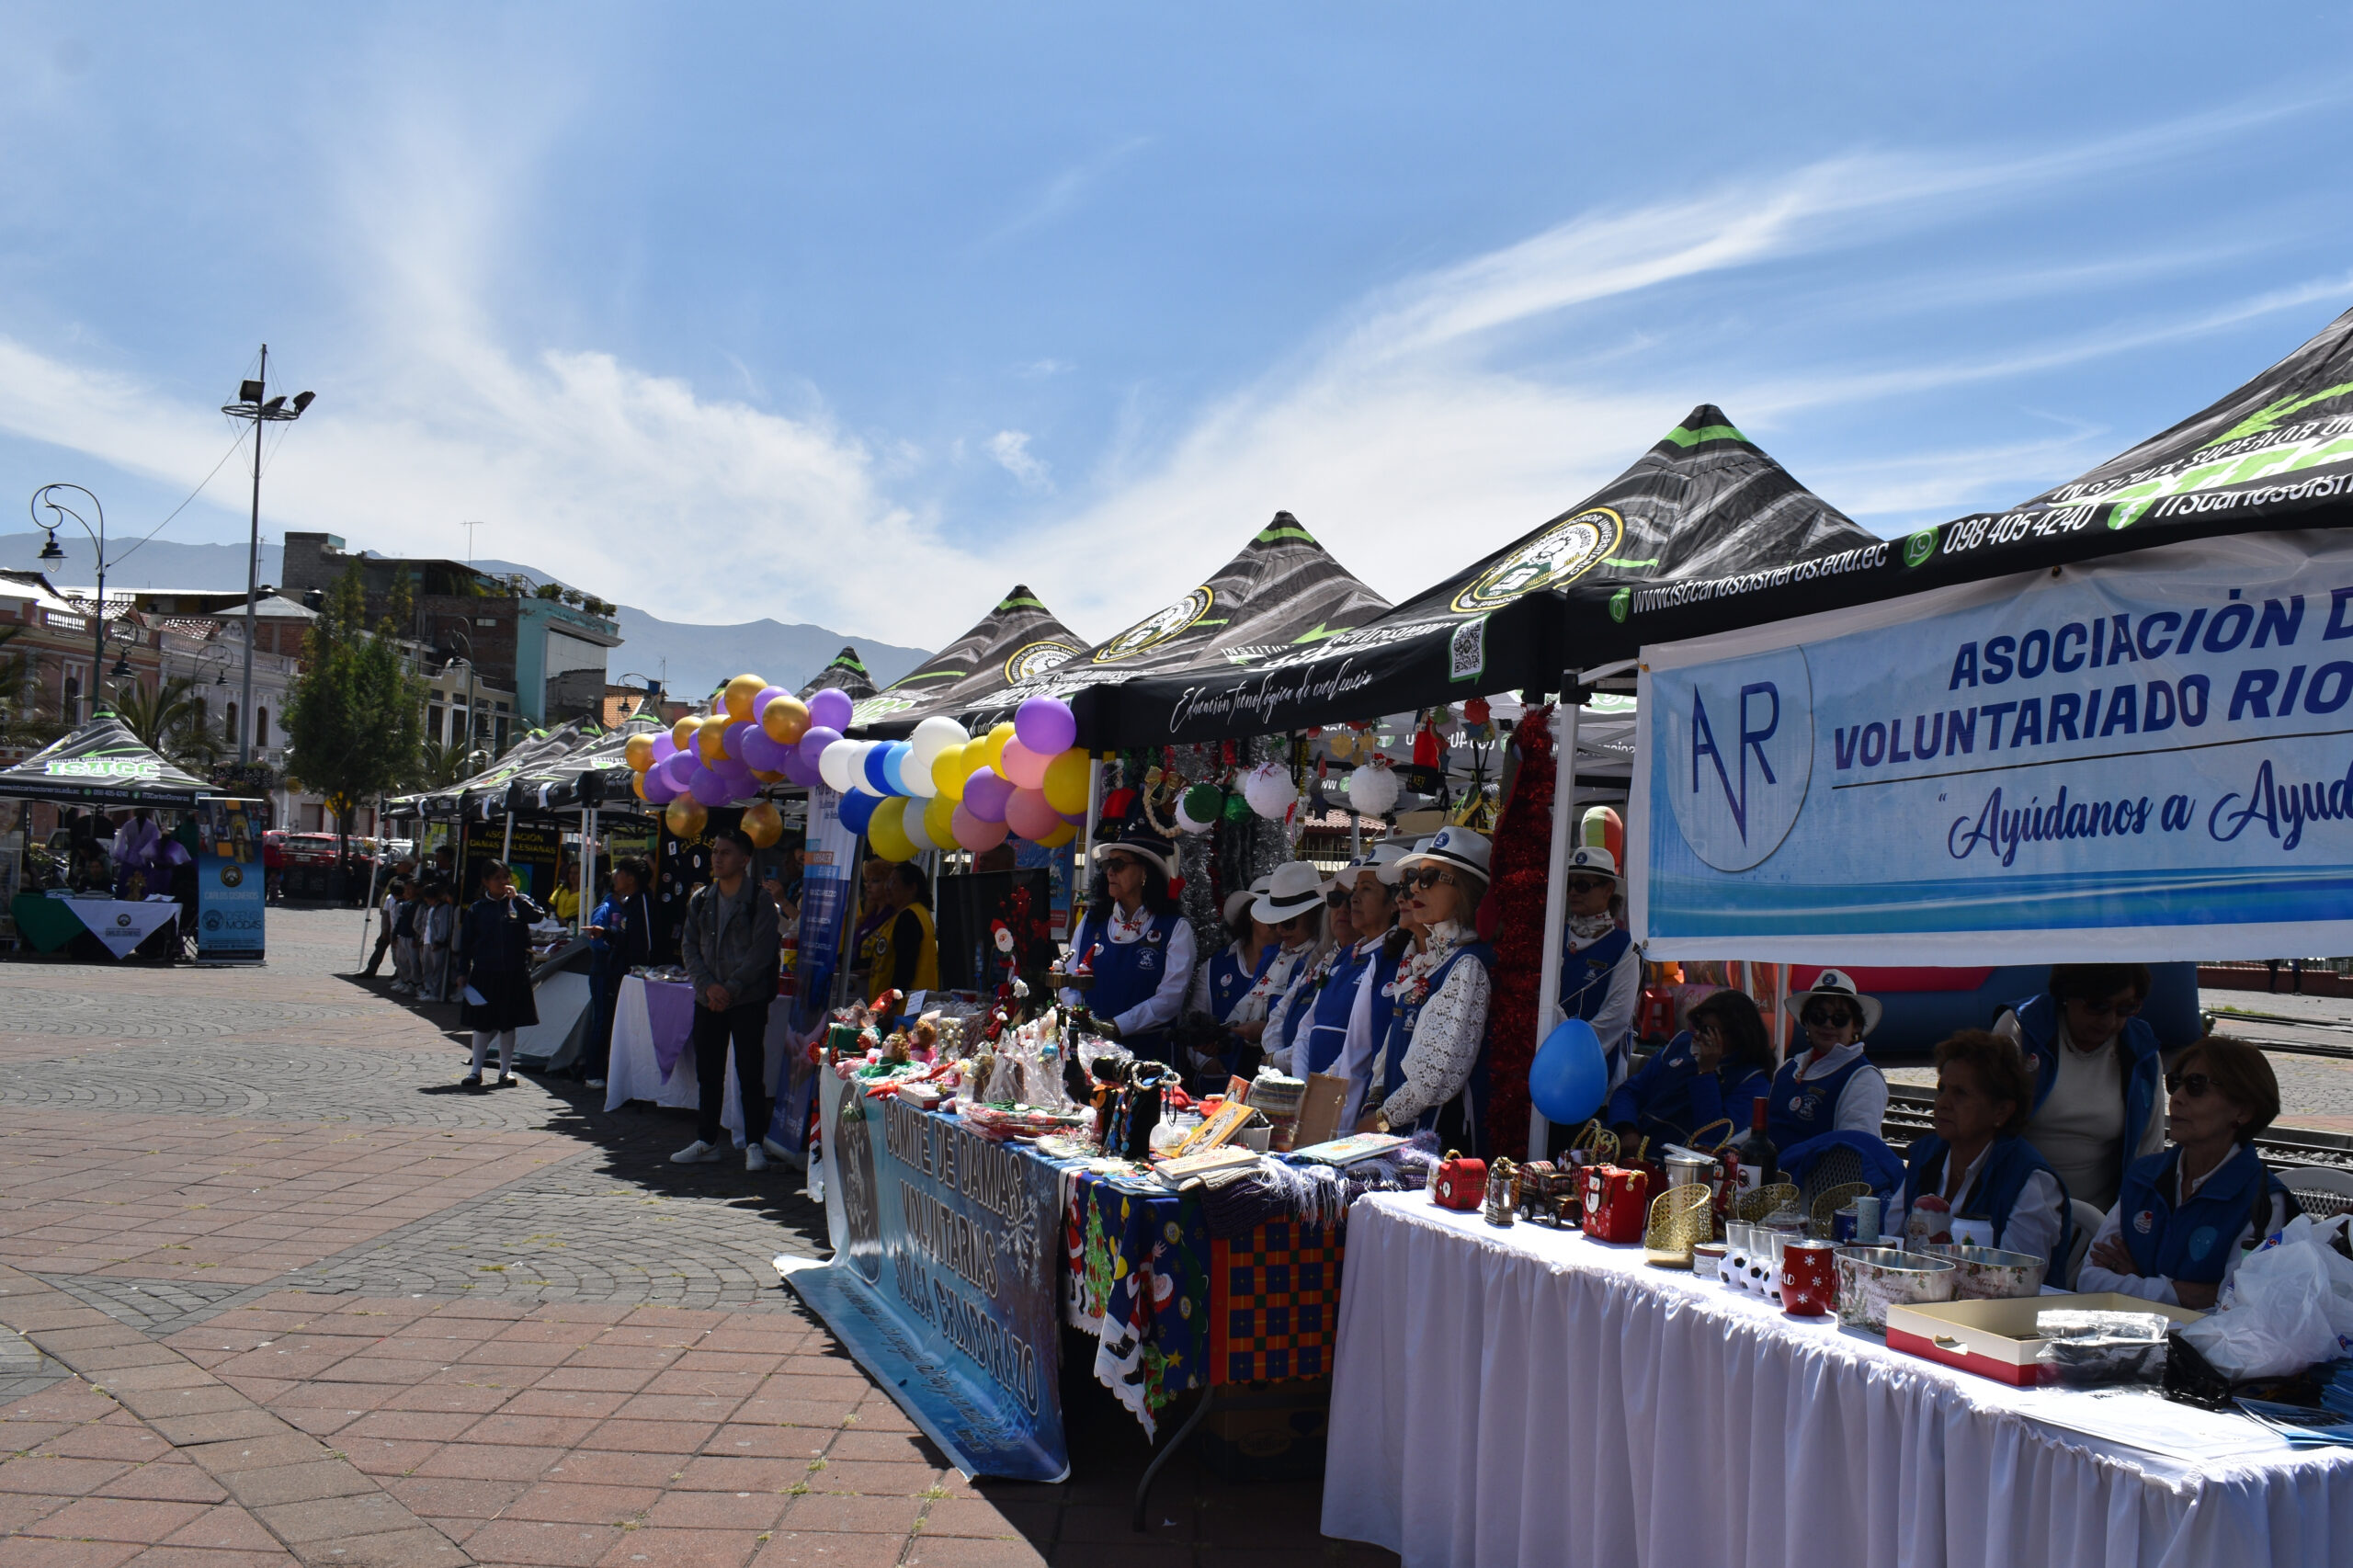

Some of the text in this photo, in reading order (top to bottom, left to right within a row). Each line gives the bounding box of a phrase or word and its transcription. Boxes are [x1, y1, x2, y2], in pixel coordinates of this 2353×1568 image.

[1943, 503, 2101, 555] 098 405 4240
[1021, 644, 1060, 657] SUPERIOR
[1061, 647, 1079, 658] UNI
[1948, 588, 2305, 691] ASOCIACIÓN
[1295, 665, 1315, 705] de
[1834, 674, 2211, 771] VOLUNTARIADO
[44, 761, 161, 778] ISUCC
[1948, 785, 2154, 868] Ayúdanos
[2160, 793, 2196, 832] a
[224, 919, 262, 930] MODAS
[934, 1118, 957, 1189] DE
[959, 1129, 1023, 1224] DAMAS
[933, 1276, 1040, 1417] CHIMBORAZO
